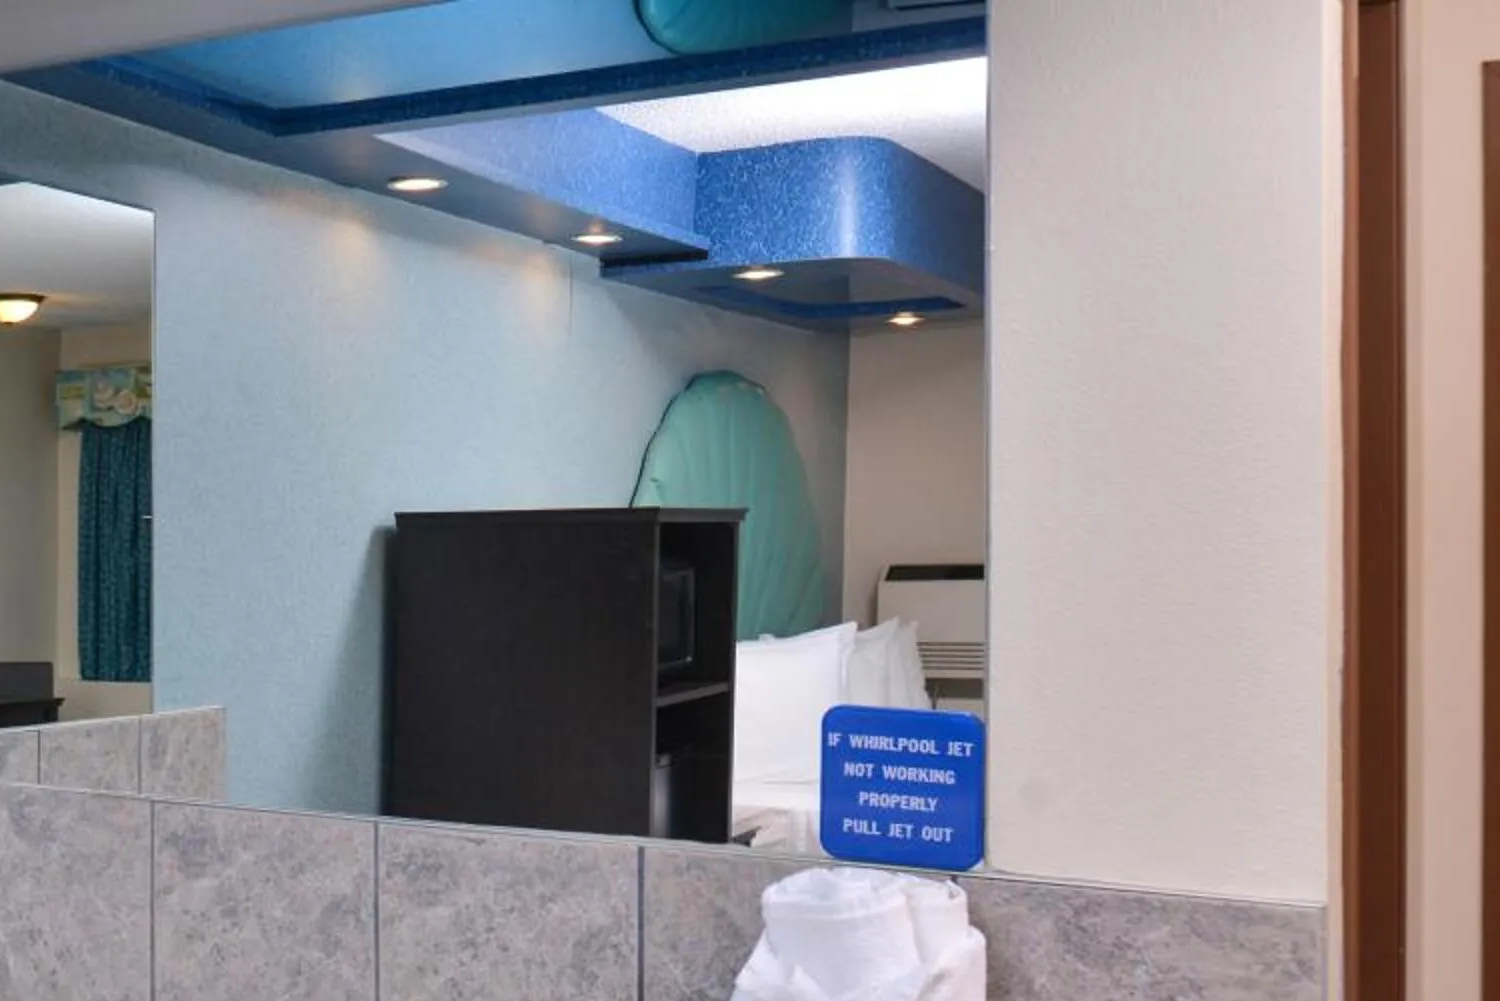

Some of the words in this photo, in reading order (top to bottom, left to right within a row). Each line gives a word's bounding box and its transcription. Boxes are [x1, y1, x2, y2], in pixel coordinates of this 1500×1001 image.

[828, 732, 842, 747] IF
[849, 734, 940, 755] WHIRLPOOL
[948, 741, 974, 757] JET
[844, 762, 874, 777] NOT
[882, 764, 956, 785] WORKING
[859, 791, 938, 812] PROPERLY
[843, 817, 881, 835] PULL
[888, 823, 914, 839] JET
[921, 826, 954, 842] OUT
